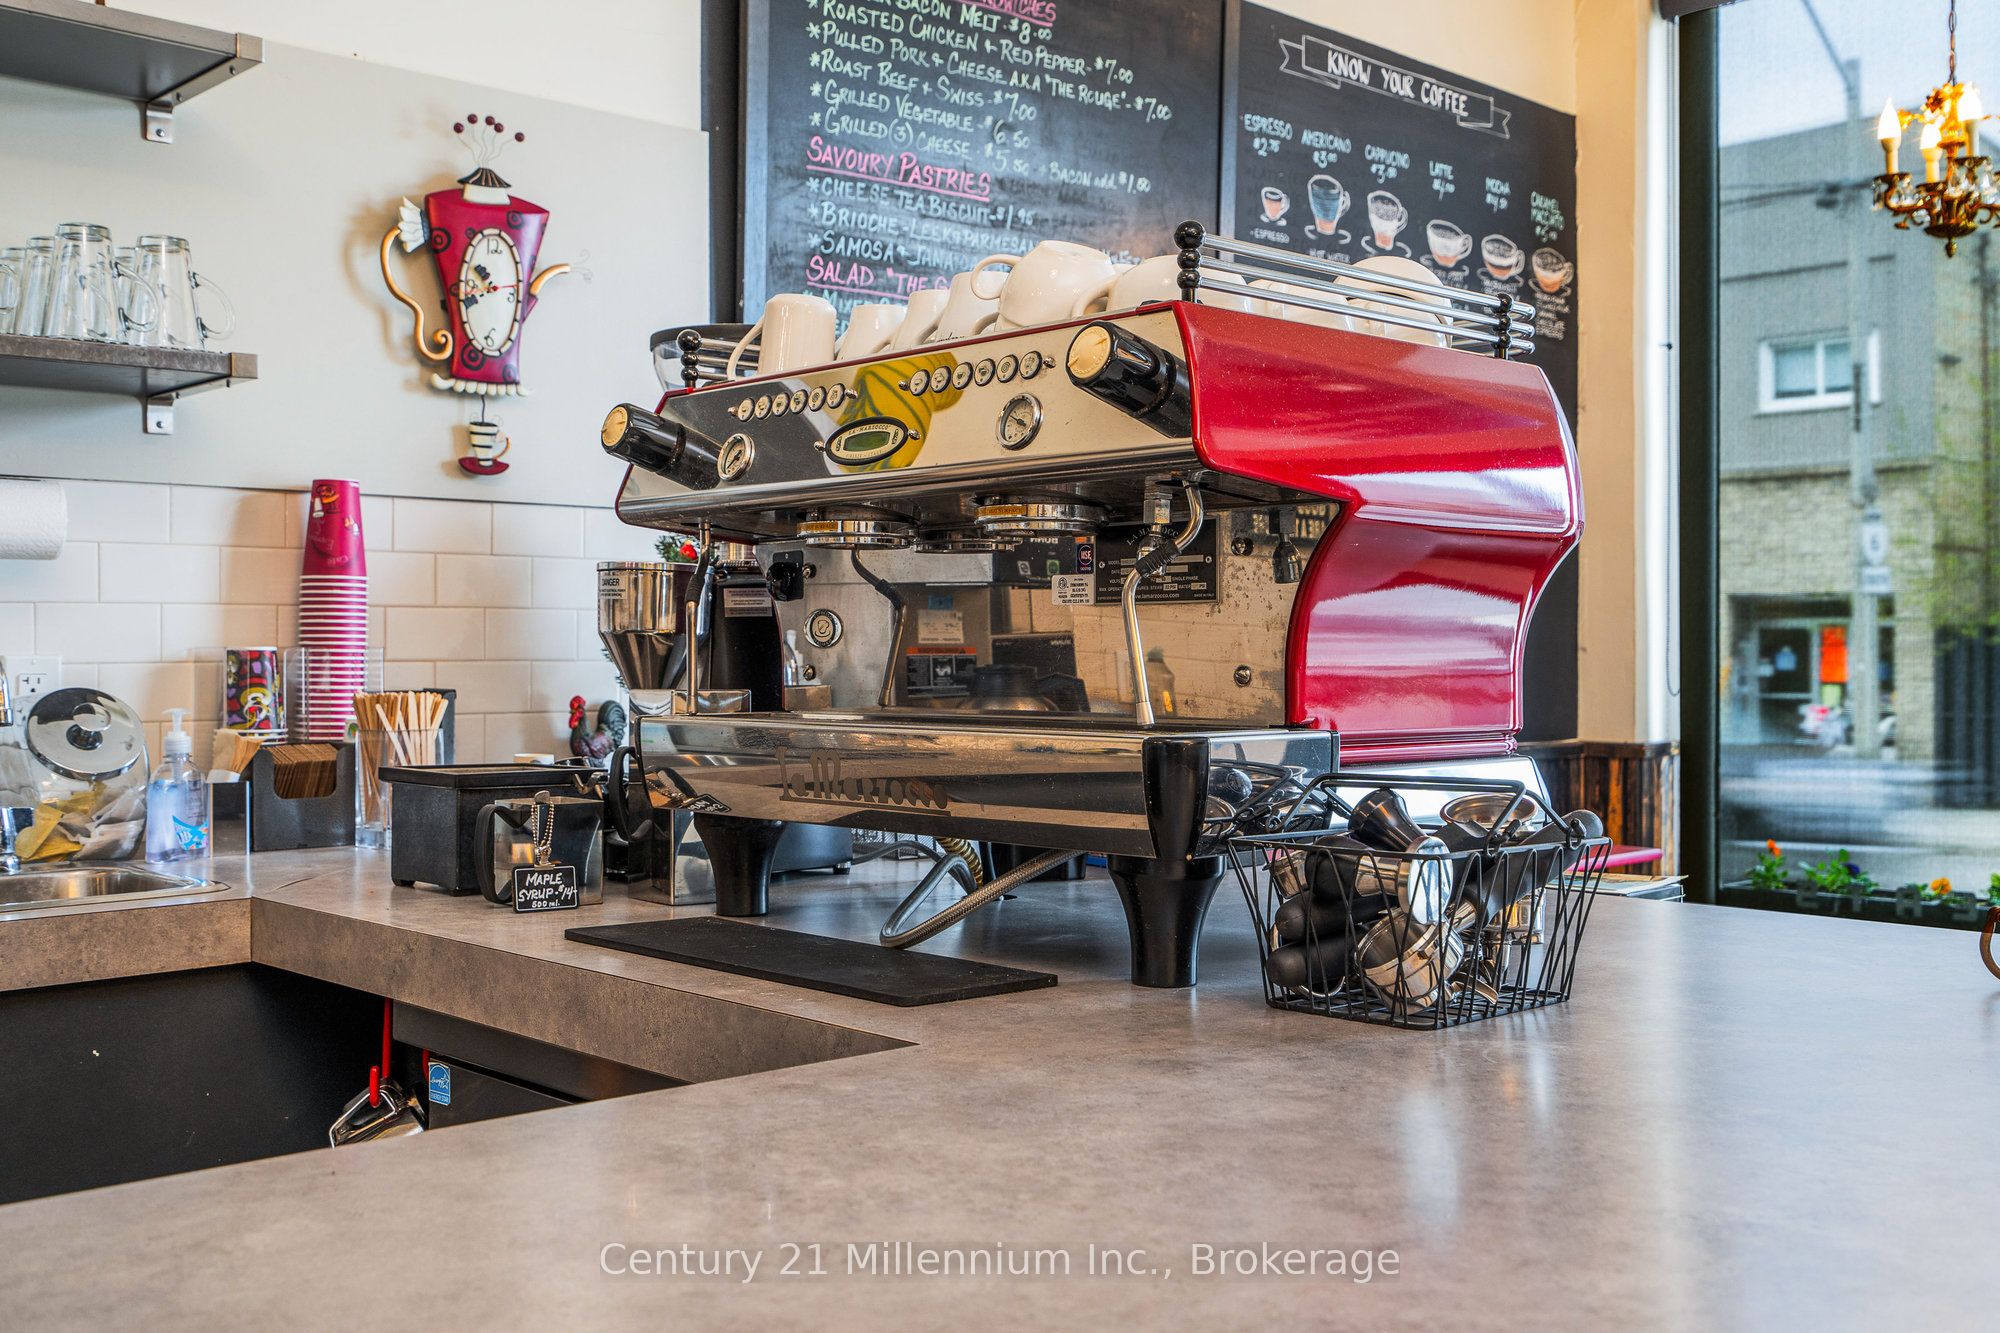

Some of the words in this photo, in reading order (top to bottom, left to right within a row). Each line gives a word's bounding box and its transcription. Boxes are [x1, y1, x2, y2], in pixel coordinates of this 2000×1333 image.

[960, 3, 1001, 33] MELT
[822, 20, 885, 55] PULLED
[890, 38, 930, 68] PORK
[947, 51, 1007, 85] CHEESE
[823, 0, 904, 33] ROASTED
[909, 13, 979, 52] CHICKEN
[1000, 39, 1033, 66] RED
[1034, 45, 1087, 77] PEPPER
[821, 48, 873, 81] ROAST
[878, 61, 920, 93] BEEF
[935, 74, 985, 107] SWISS
[1328, 49, 1371, 86] KNOW
[1382, 67, 1416, 99] YOUR
[1421, 81, 1469, 117] COFFEE
[824, 78, 890, 113] GRILLED
[896, 93, 974, 133] VEGETABLE
[1244, 113, 1293, 141] ESPRESSO
[1301, 128, 1352, 154] AMERICANO
[824, 106, 888, 140] GRILLED
[916, 131, 973, 161] CHEESE
[1049, 161, 1092, 187] BACON
[807, 135, 894, 178] SAVOURY
[899, 151, 991, 197] PASTRIES
[1429, 160, 1454, 180] LATTE
[821, 177, 890, 206] CHEESE
[894, 189, 926, 213] TEA
[928, 195, 991, 222] BISCUIT
[821, 201, 899, 236] BRIOCHE
[486, 238, 503, 255] 12
[820, 230, 895, 264] SAMOSA
[806, 255, 875, 287] SALAD
[526, 872, 563, 887] MAPLE
